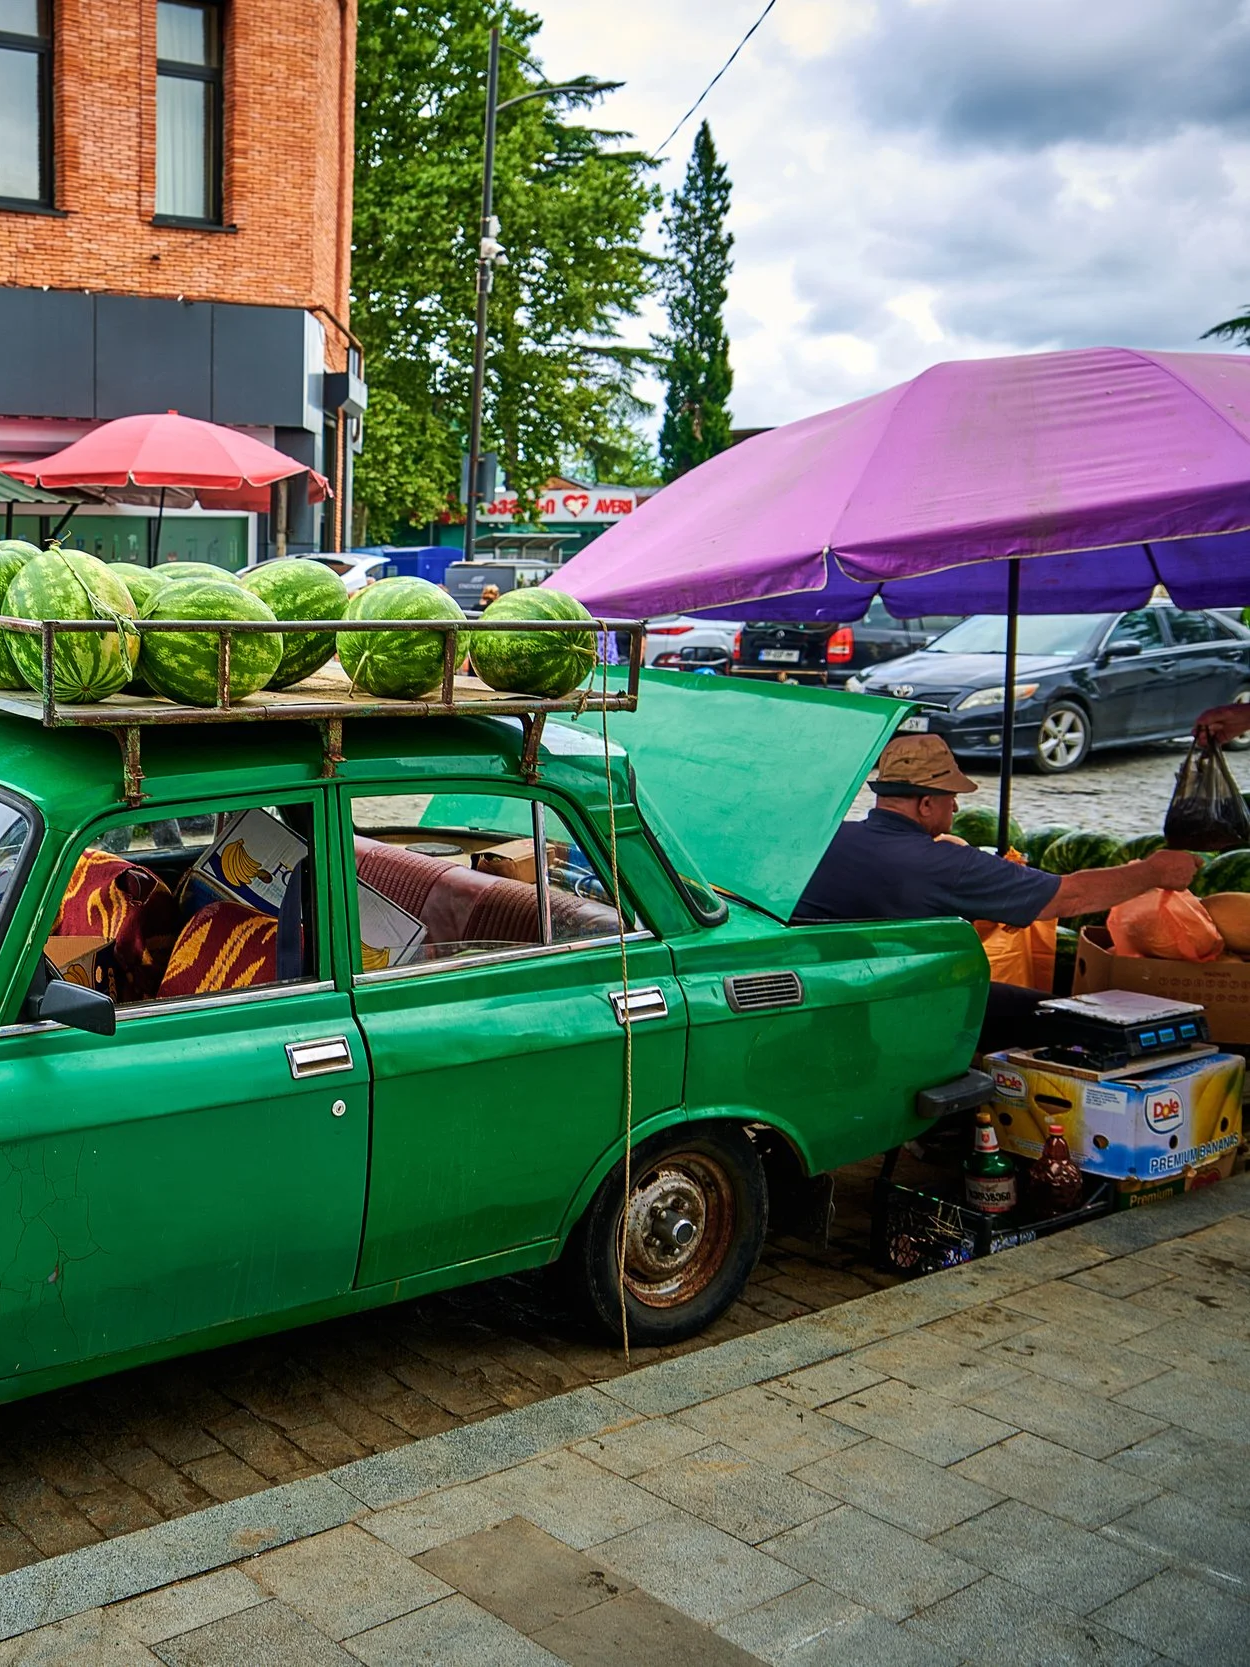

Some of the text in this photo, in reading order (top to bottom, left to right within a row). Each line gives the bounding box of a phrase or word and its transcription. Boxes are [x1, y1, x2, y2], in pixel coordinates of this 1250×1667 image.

[594, 499, 632, 514] AVERSI
[996, 1073, 1022, 1089] Dole
[1153, 1098, 1180, 1119] Dole
[1150, 1132, 1239, 1173] PREMIUM BANANAS
[1129, 1186, 1174, 1208] Premium
